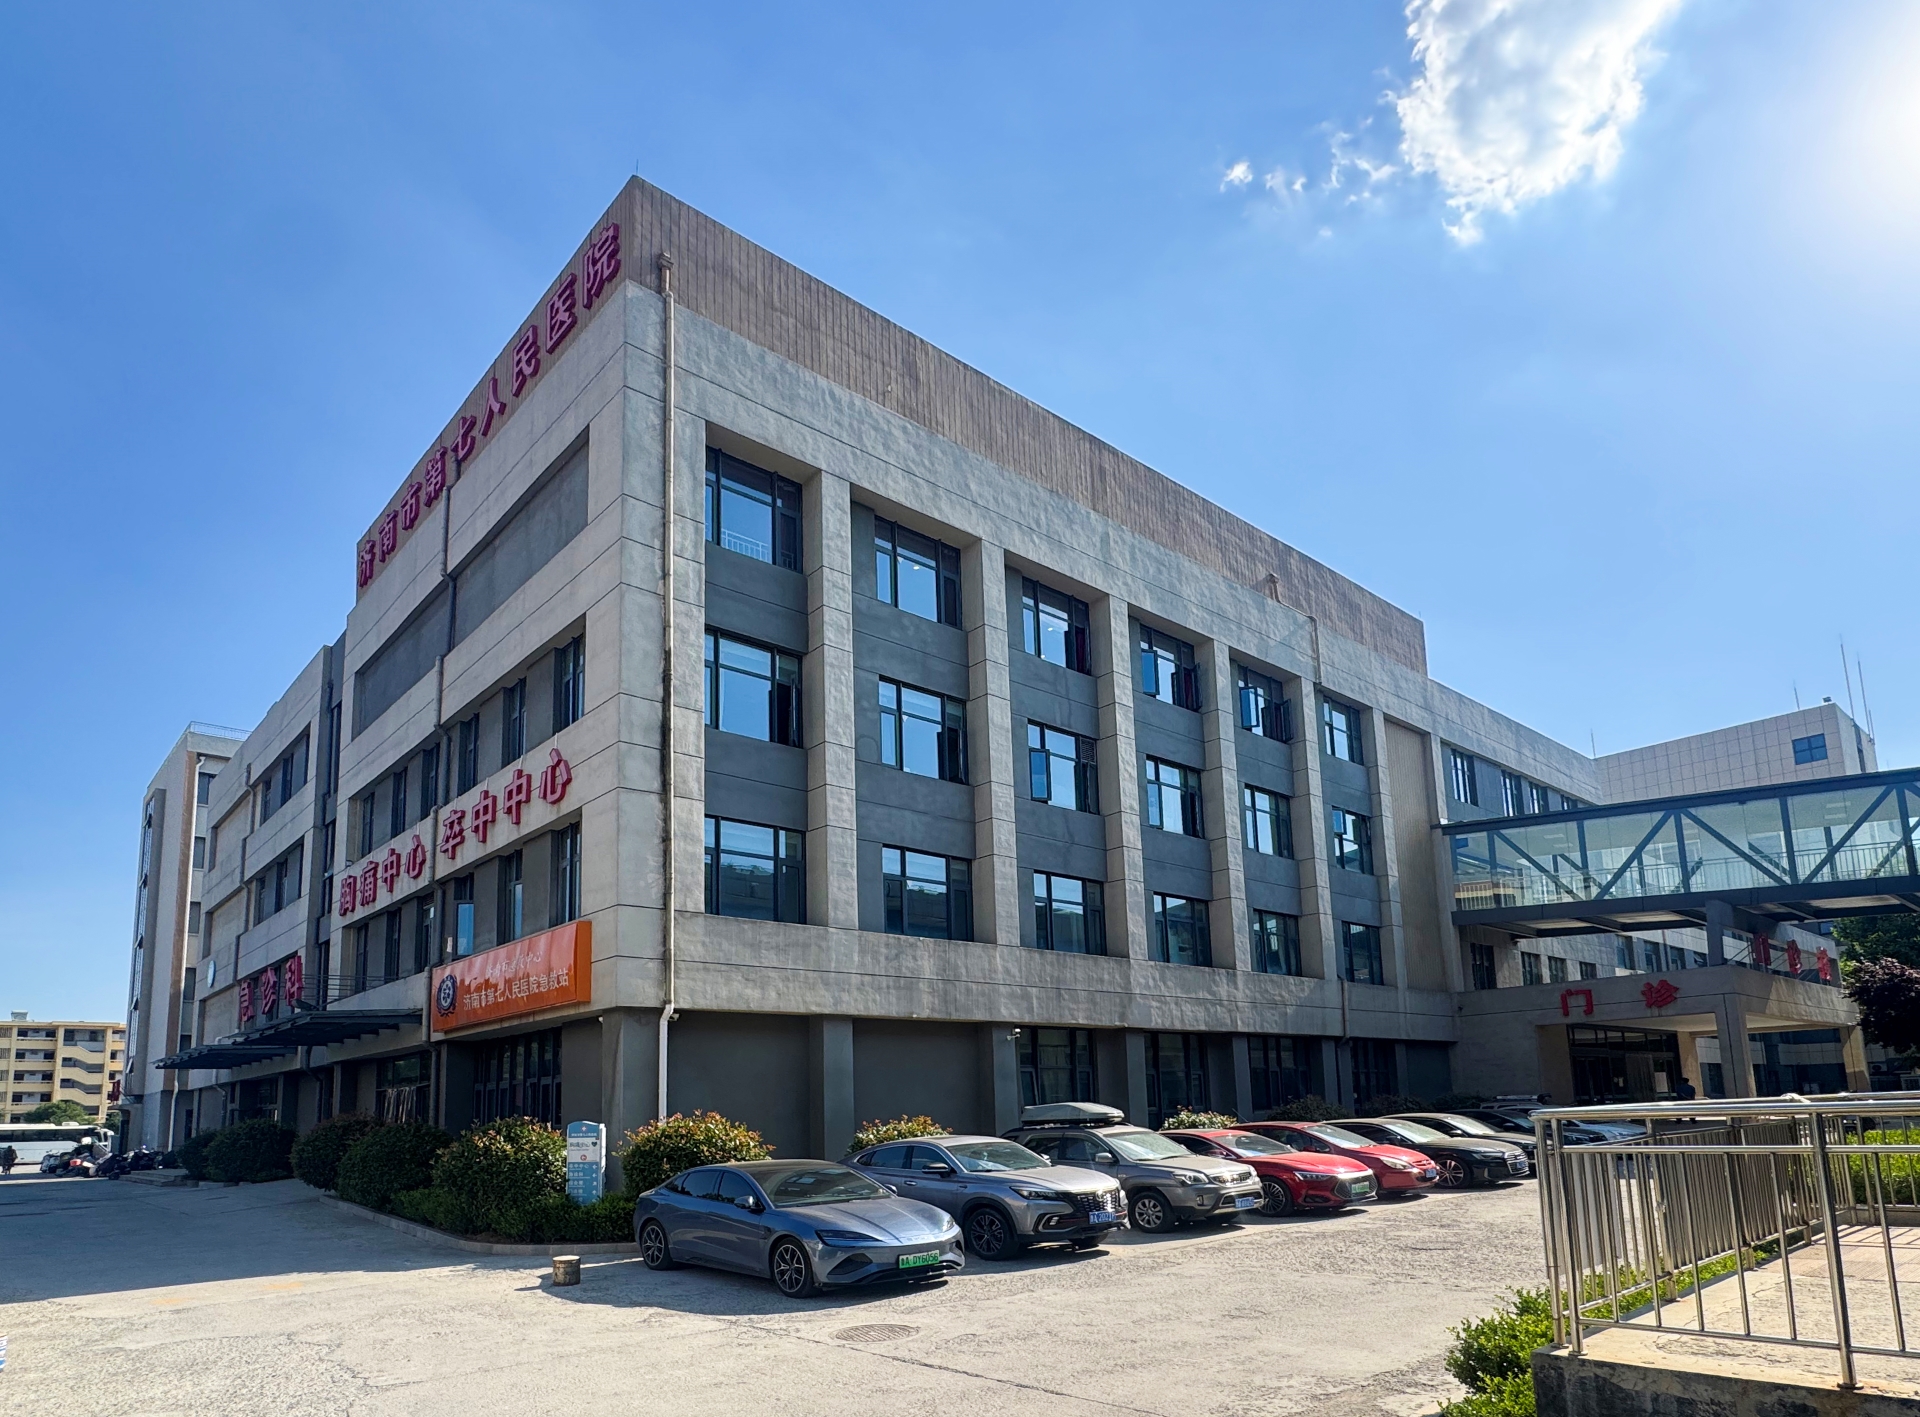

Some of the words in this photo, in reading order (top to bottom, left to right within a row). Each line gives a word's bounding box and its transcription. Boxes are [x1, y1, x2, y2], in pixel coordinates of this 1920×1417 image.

[358, 222, 622, 588] 济南市第七人民医院
[339, 834, 428, 916] 胸痛中心
[440, 748, 573, 860] 卒中中心
[240, 954, 305, 1023] 急诊科
[463, 968, 569, 1010] 济南市第七人民医院急救站
[1560, 979, 1680, 1017] 门诊
